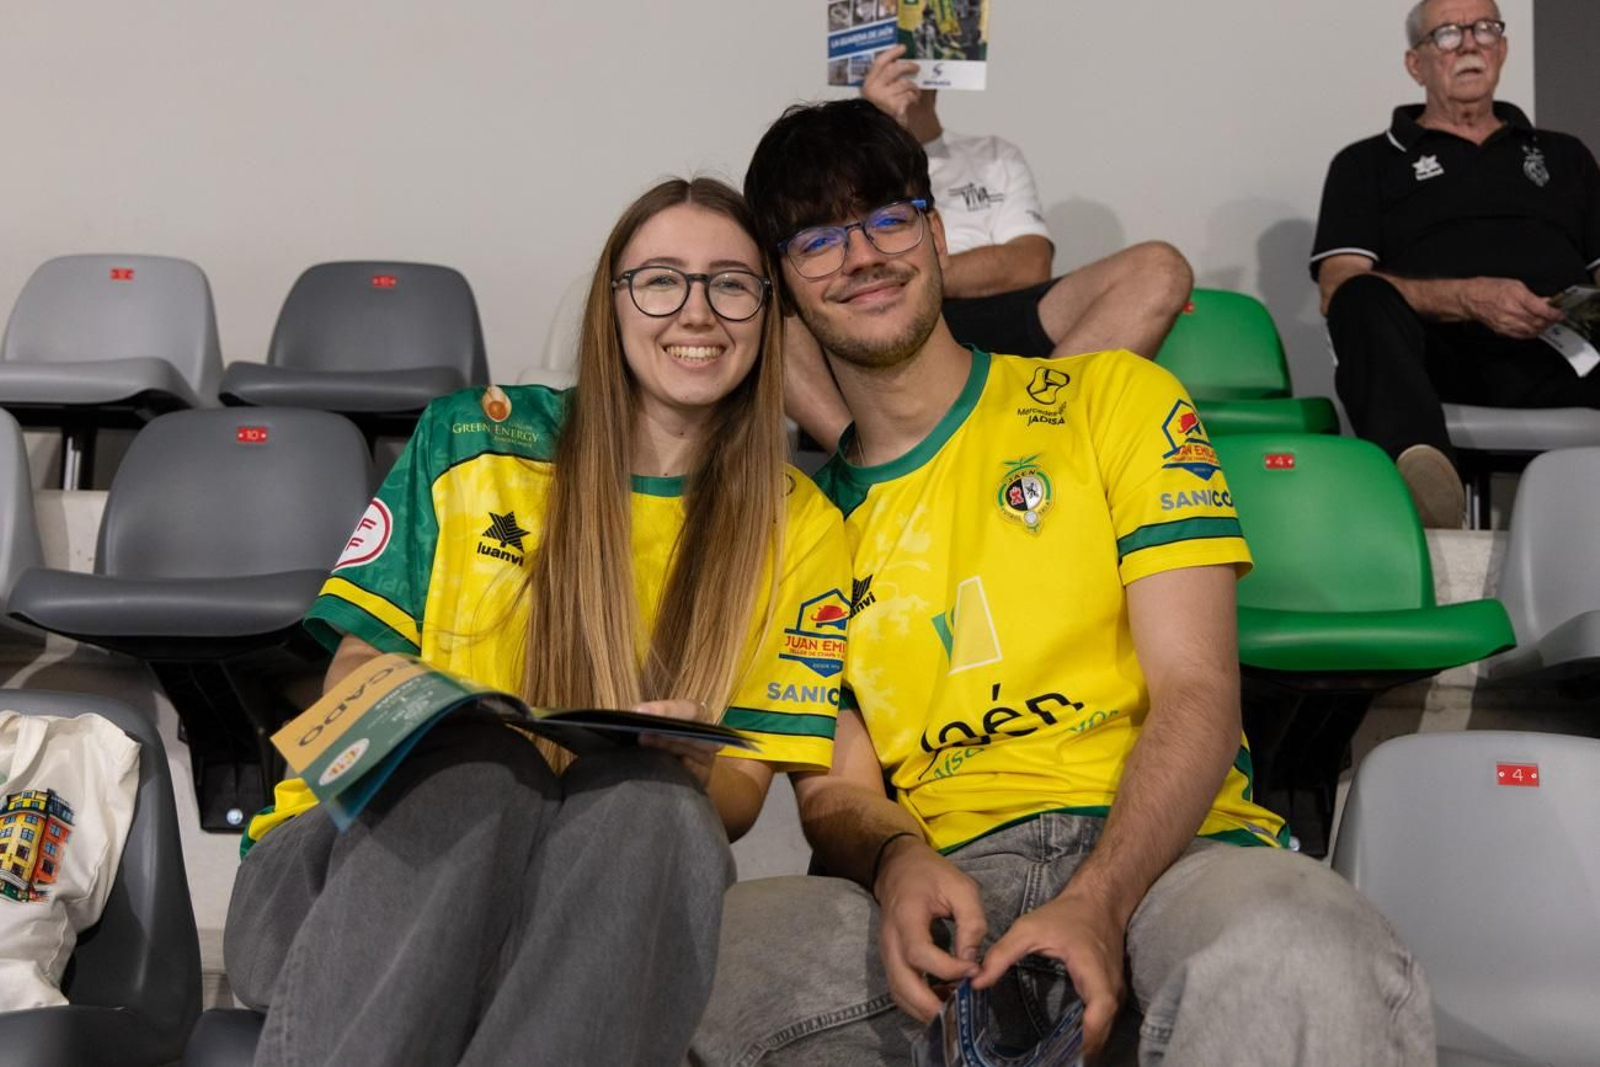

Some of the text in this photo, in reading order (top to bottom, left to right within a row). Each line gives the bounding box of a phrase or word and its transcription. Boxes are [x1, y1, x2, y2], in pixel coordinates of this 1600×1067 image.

[246, 429, 259, 441] 10
[452, 422, 491, 434] GREEN
[494, 425, 540, 443] ENERGY
[1275, 456, 1285, 467] 4
[477, 541, 525, 567] luanvi
[785, 635, 818, 650] JUAN
[1512, 768, 1524, 783] 4
